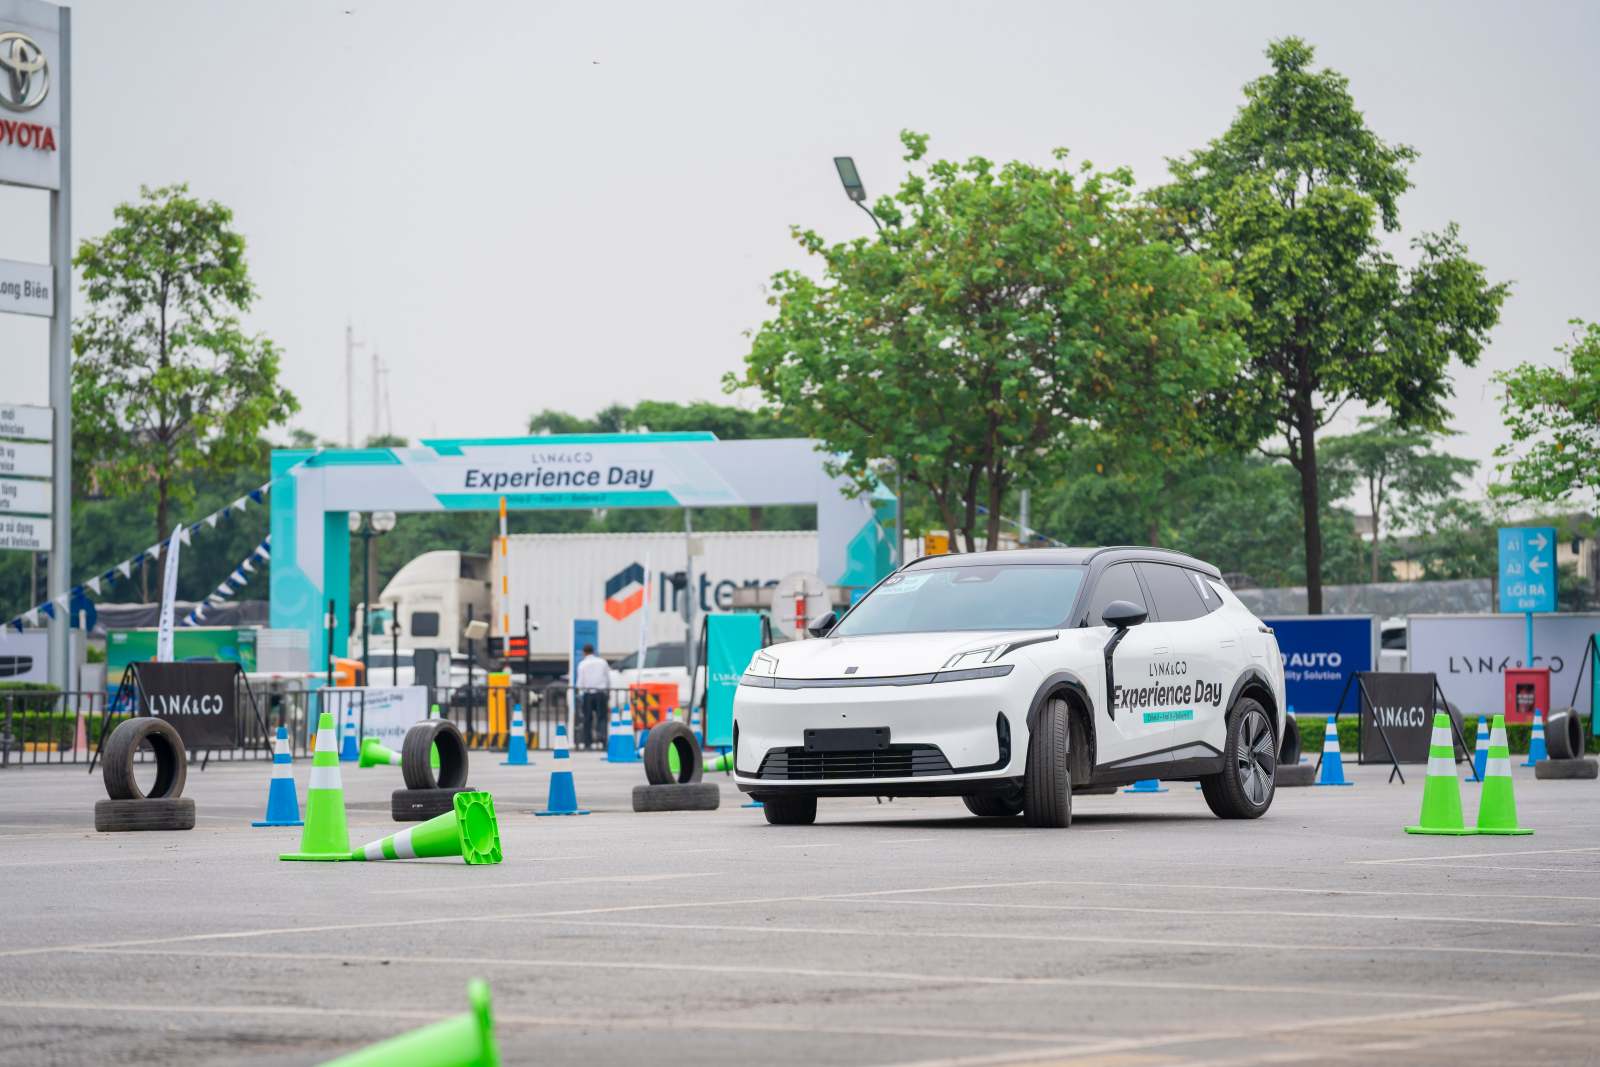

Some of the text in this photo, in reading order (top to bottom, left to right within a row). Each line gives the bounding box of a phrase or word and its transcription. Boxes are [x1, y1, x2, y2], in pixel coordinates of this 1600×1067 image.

[0, 281, 21, 300] ong
[464, 466, 654, 491] Experience Day
[1290, 652, 1342, 667] AUTO
[1114, 680, 1223, 713] Experience Day
